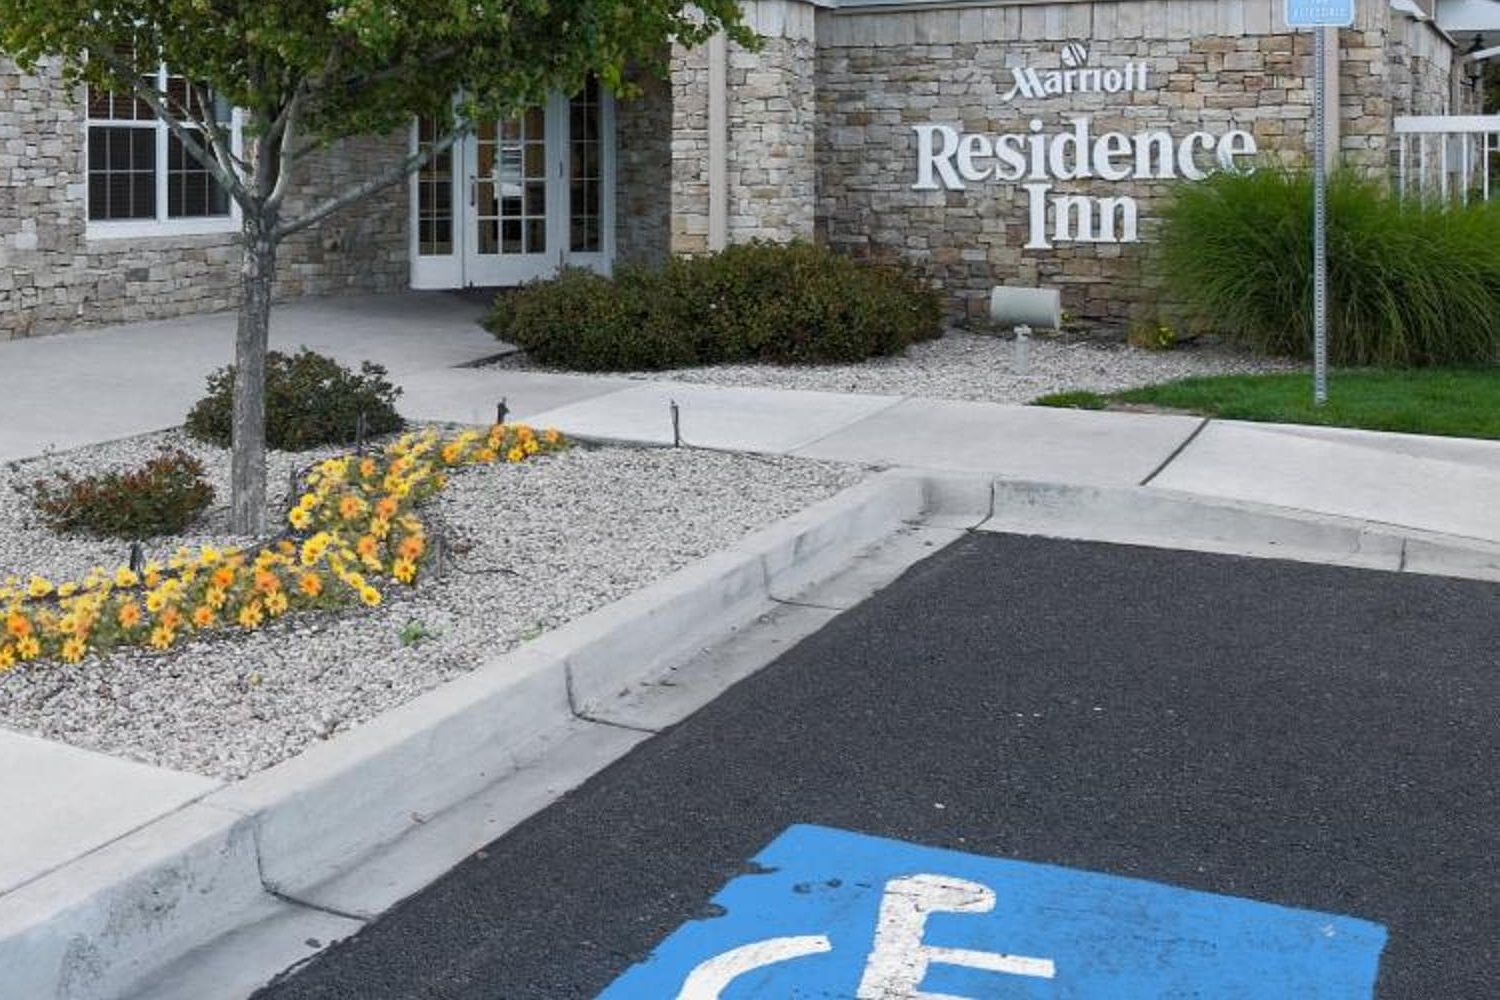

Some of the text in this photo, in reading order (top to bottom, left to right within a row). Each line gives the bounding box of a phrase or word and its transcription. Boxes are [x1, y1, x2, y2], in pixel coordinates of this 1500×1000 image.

[1002, 62, 1149, 101] Marriott
[911, 118, 1258, 191] Residence
[1022, 183, 1140, 249] Inn
